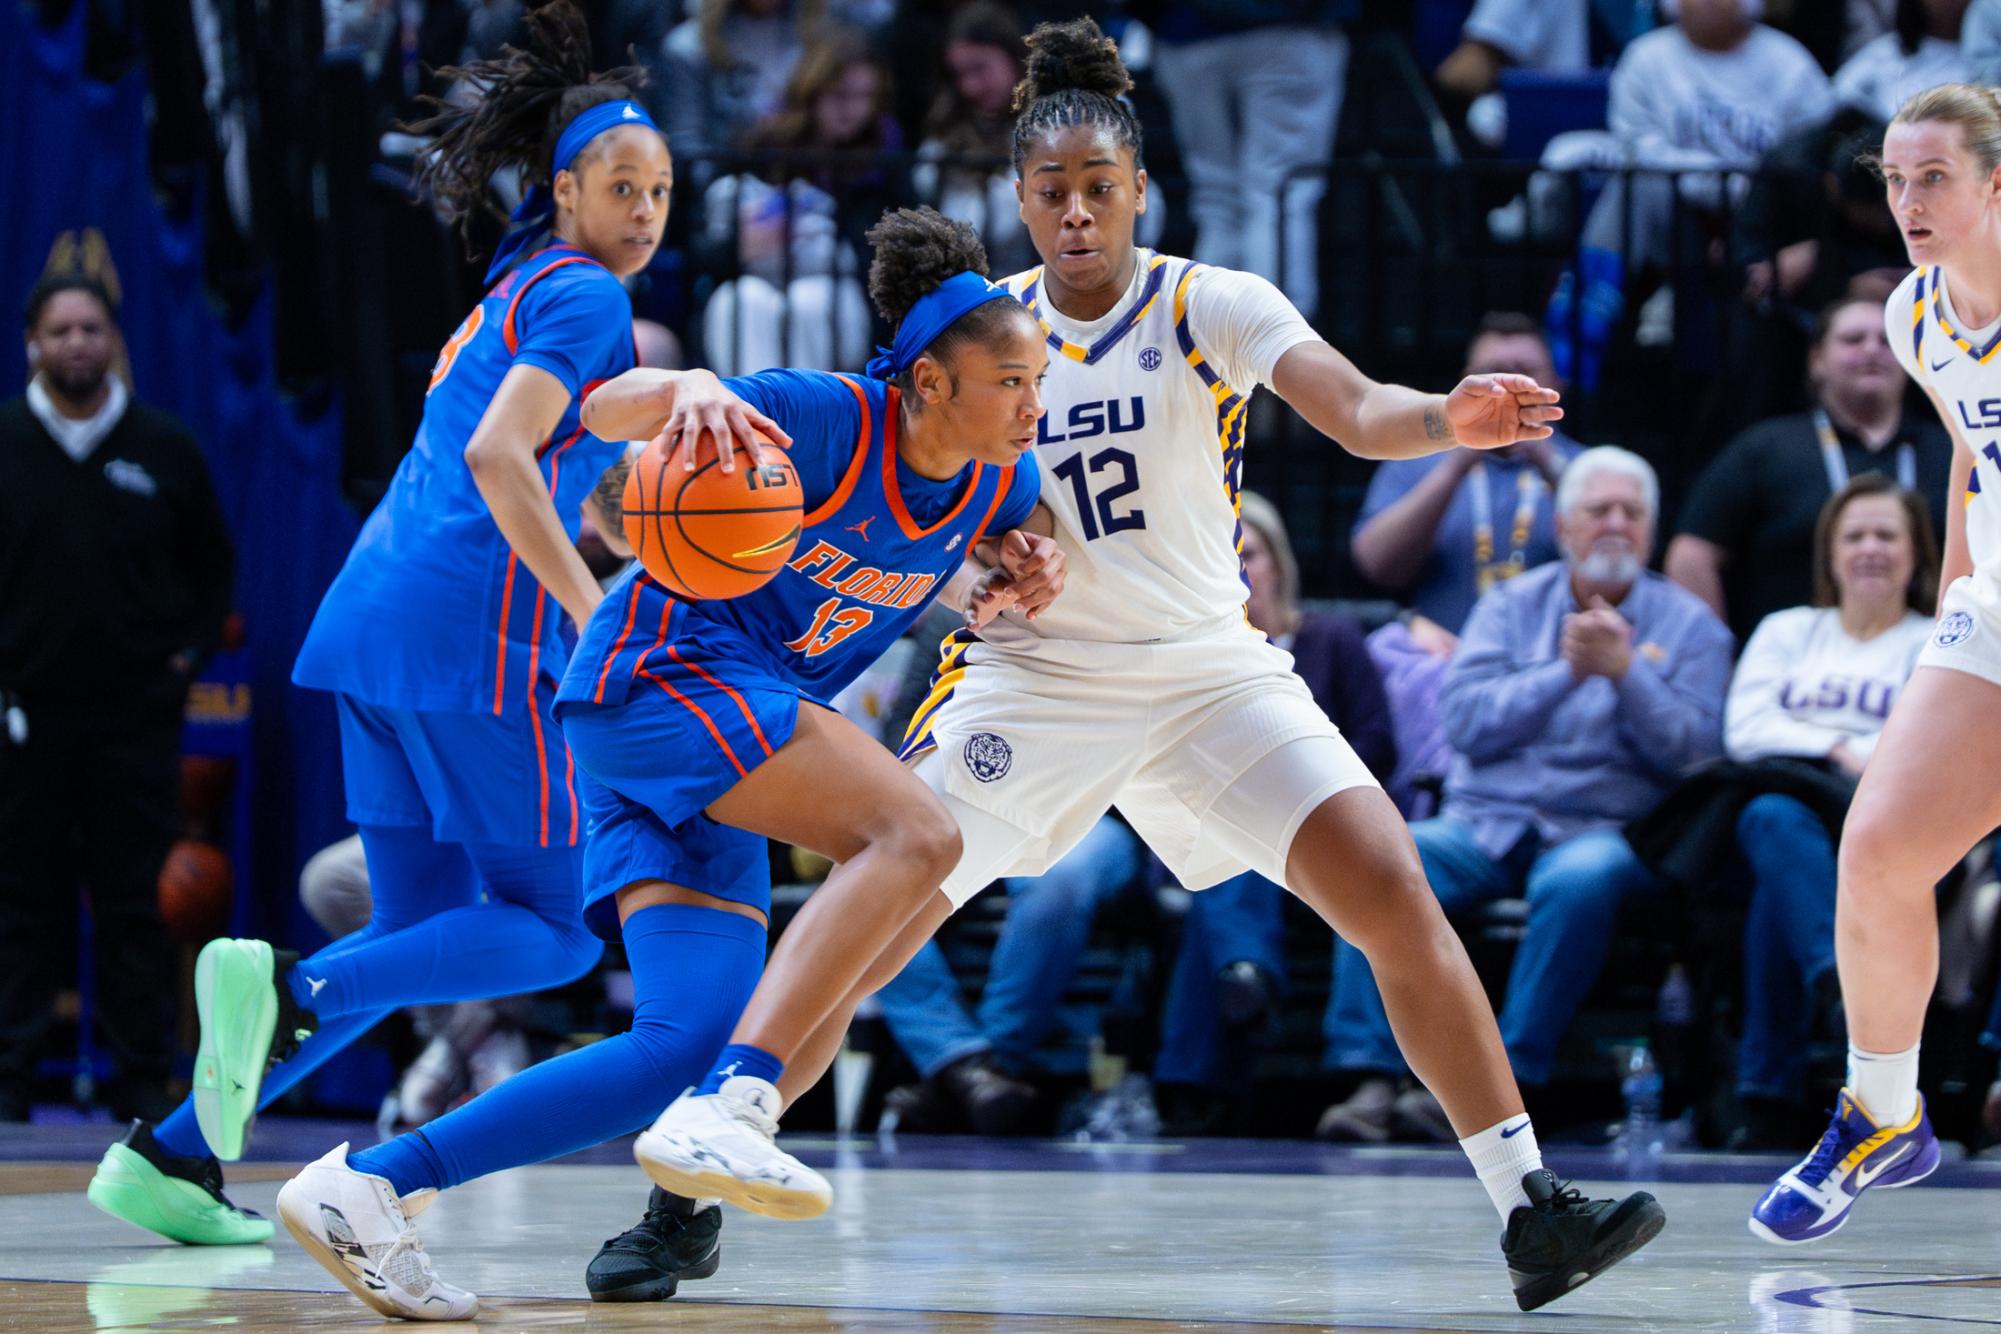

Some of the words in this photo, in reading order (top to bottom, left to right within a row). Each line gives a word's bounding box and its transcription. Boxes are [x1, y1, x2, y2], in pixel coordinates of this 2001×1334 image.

[1139, 348, 1161, 370] SEC
[1037, 396, 1145, 445] LSU
[1052, 447, 1146, 541] 12
[786, 539, 947, 609] FLORID
[783, 597, 874, 658] 13
